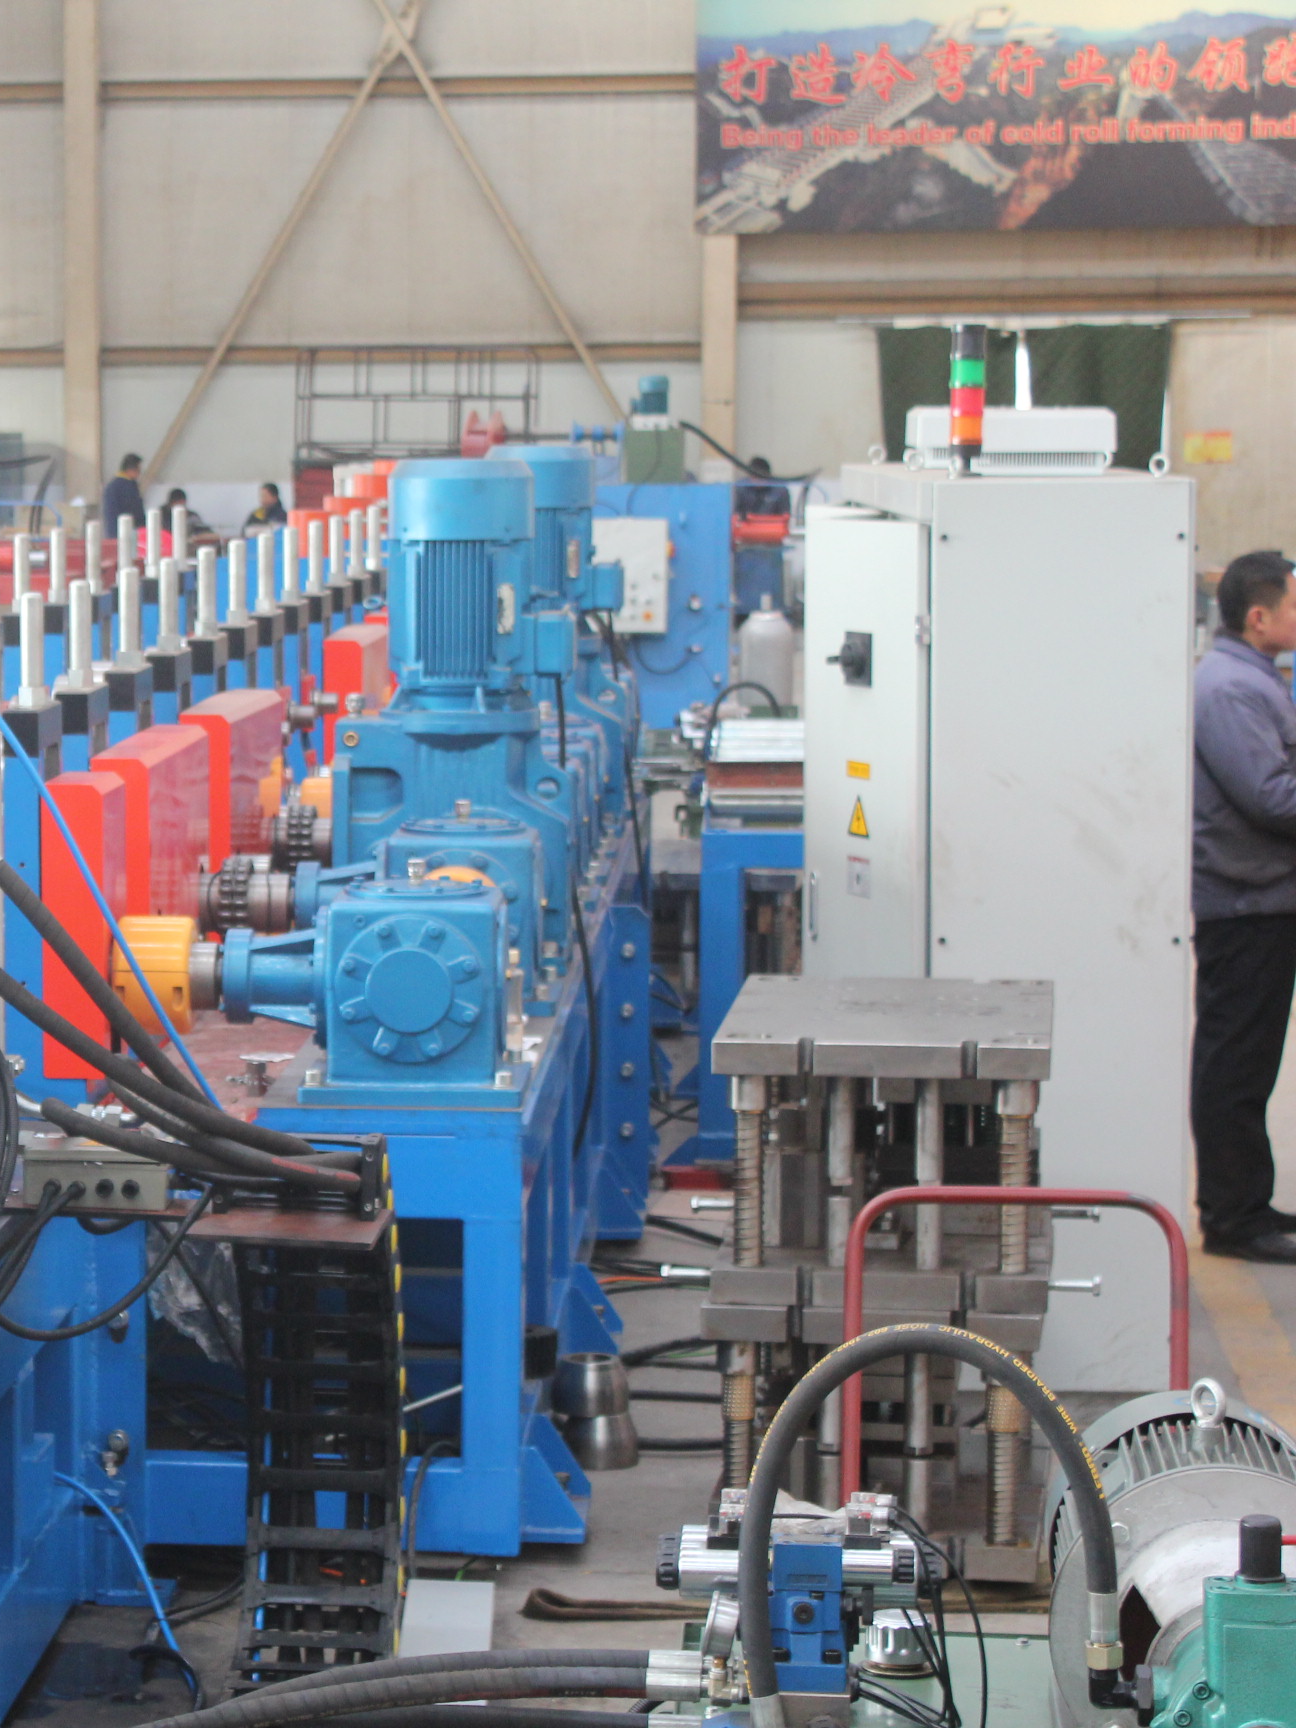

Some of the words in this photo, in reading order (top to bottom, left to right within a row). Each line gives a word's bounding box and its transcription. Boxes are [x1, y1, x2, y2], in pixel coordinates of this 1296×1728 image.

[721, 123, 803, 150] Being
[813, 124, 861, 146] the
[866, 123, 956, 146] leader
[964, 118, 998, 145] of
[1000, 117, 1064, 145] cold
[1071, 116, 1120, 142] roll
[1126, 115, 1245, 144] forming
[937, 1324, 1010, 1358] HYDRAULIC
[1012, 1358, 1057, 1401] BRAIDED
[1056, 1403, 1080, 1434] WIRE
